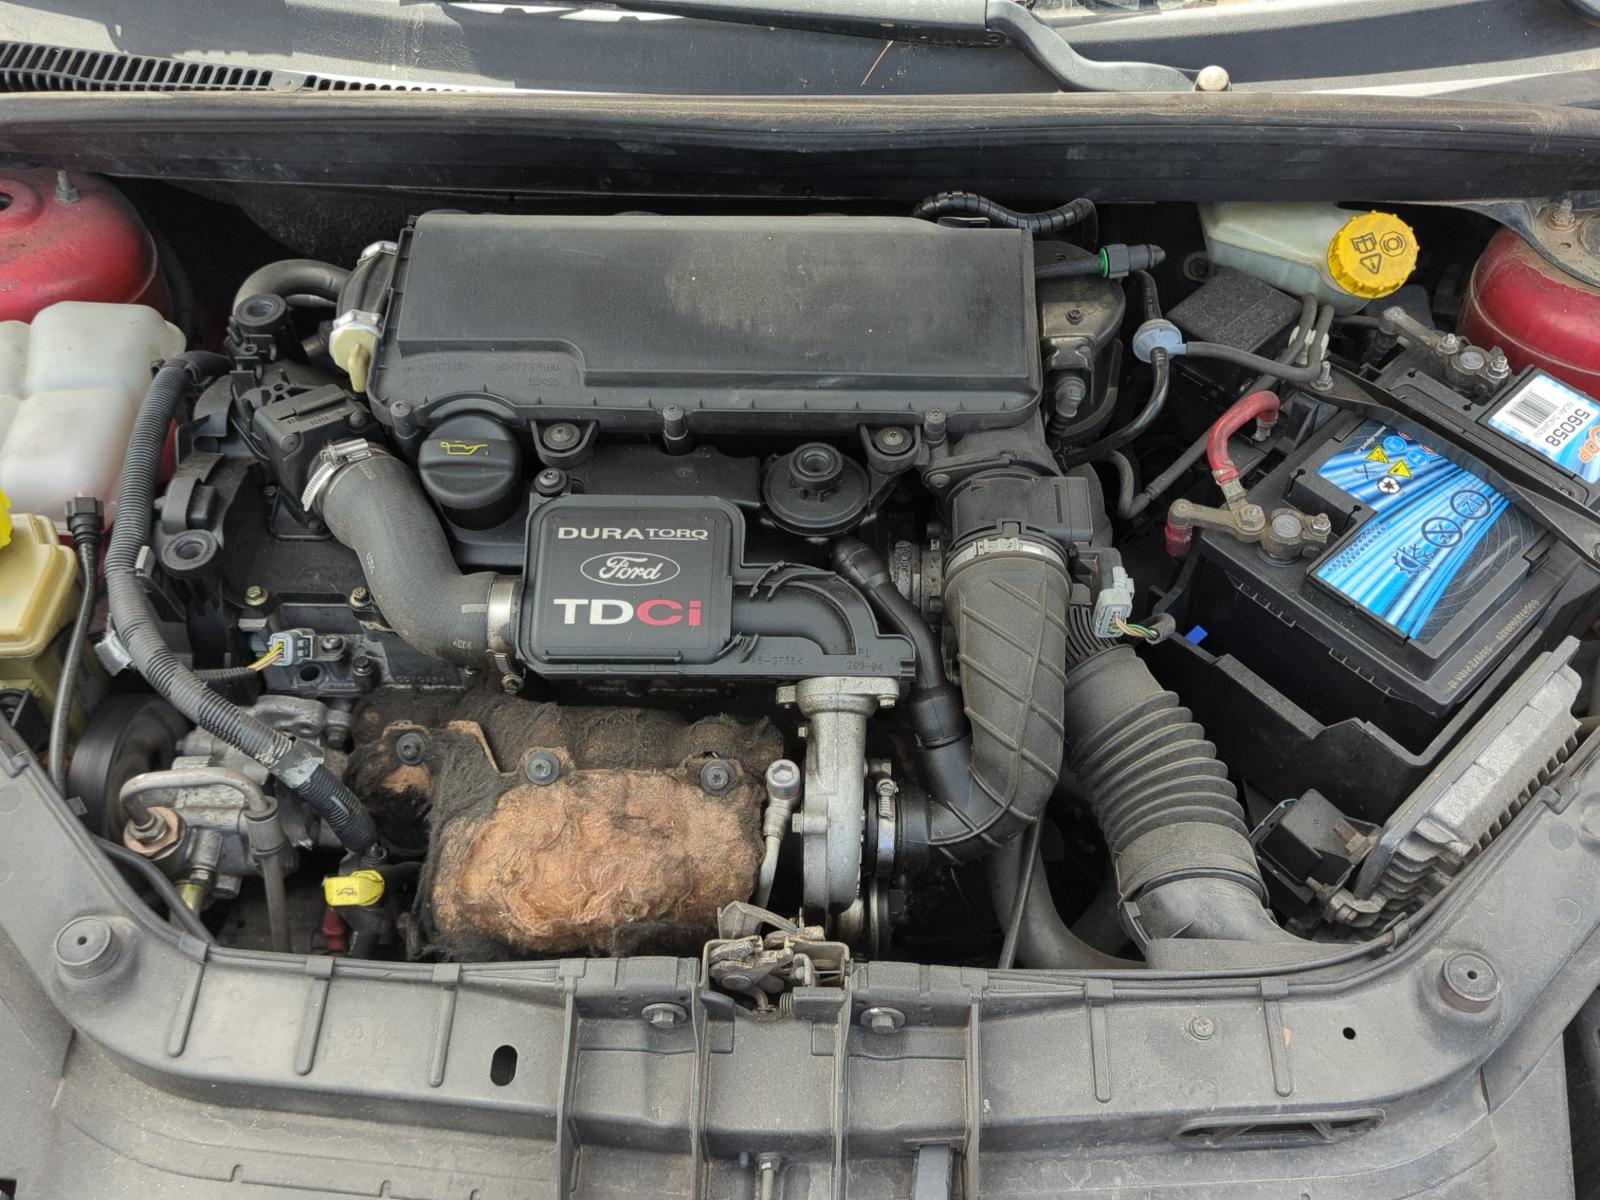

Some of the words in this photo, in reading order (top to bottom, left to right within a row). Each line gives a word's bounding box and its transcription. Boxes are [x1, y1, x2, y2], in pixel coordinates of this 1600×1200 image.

[1545, 408, 1590, 447] 56058
[557, 527, 709, 541] DURATORQ
[598, 555, 664, 580] Ford
[553, 598, 703, 626] TDCi
